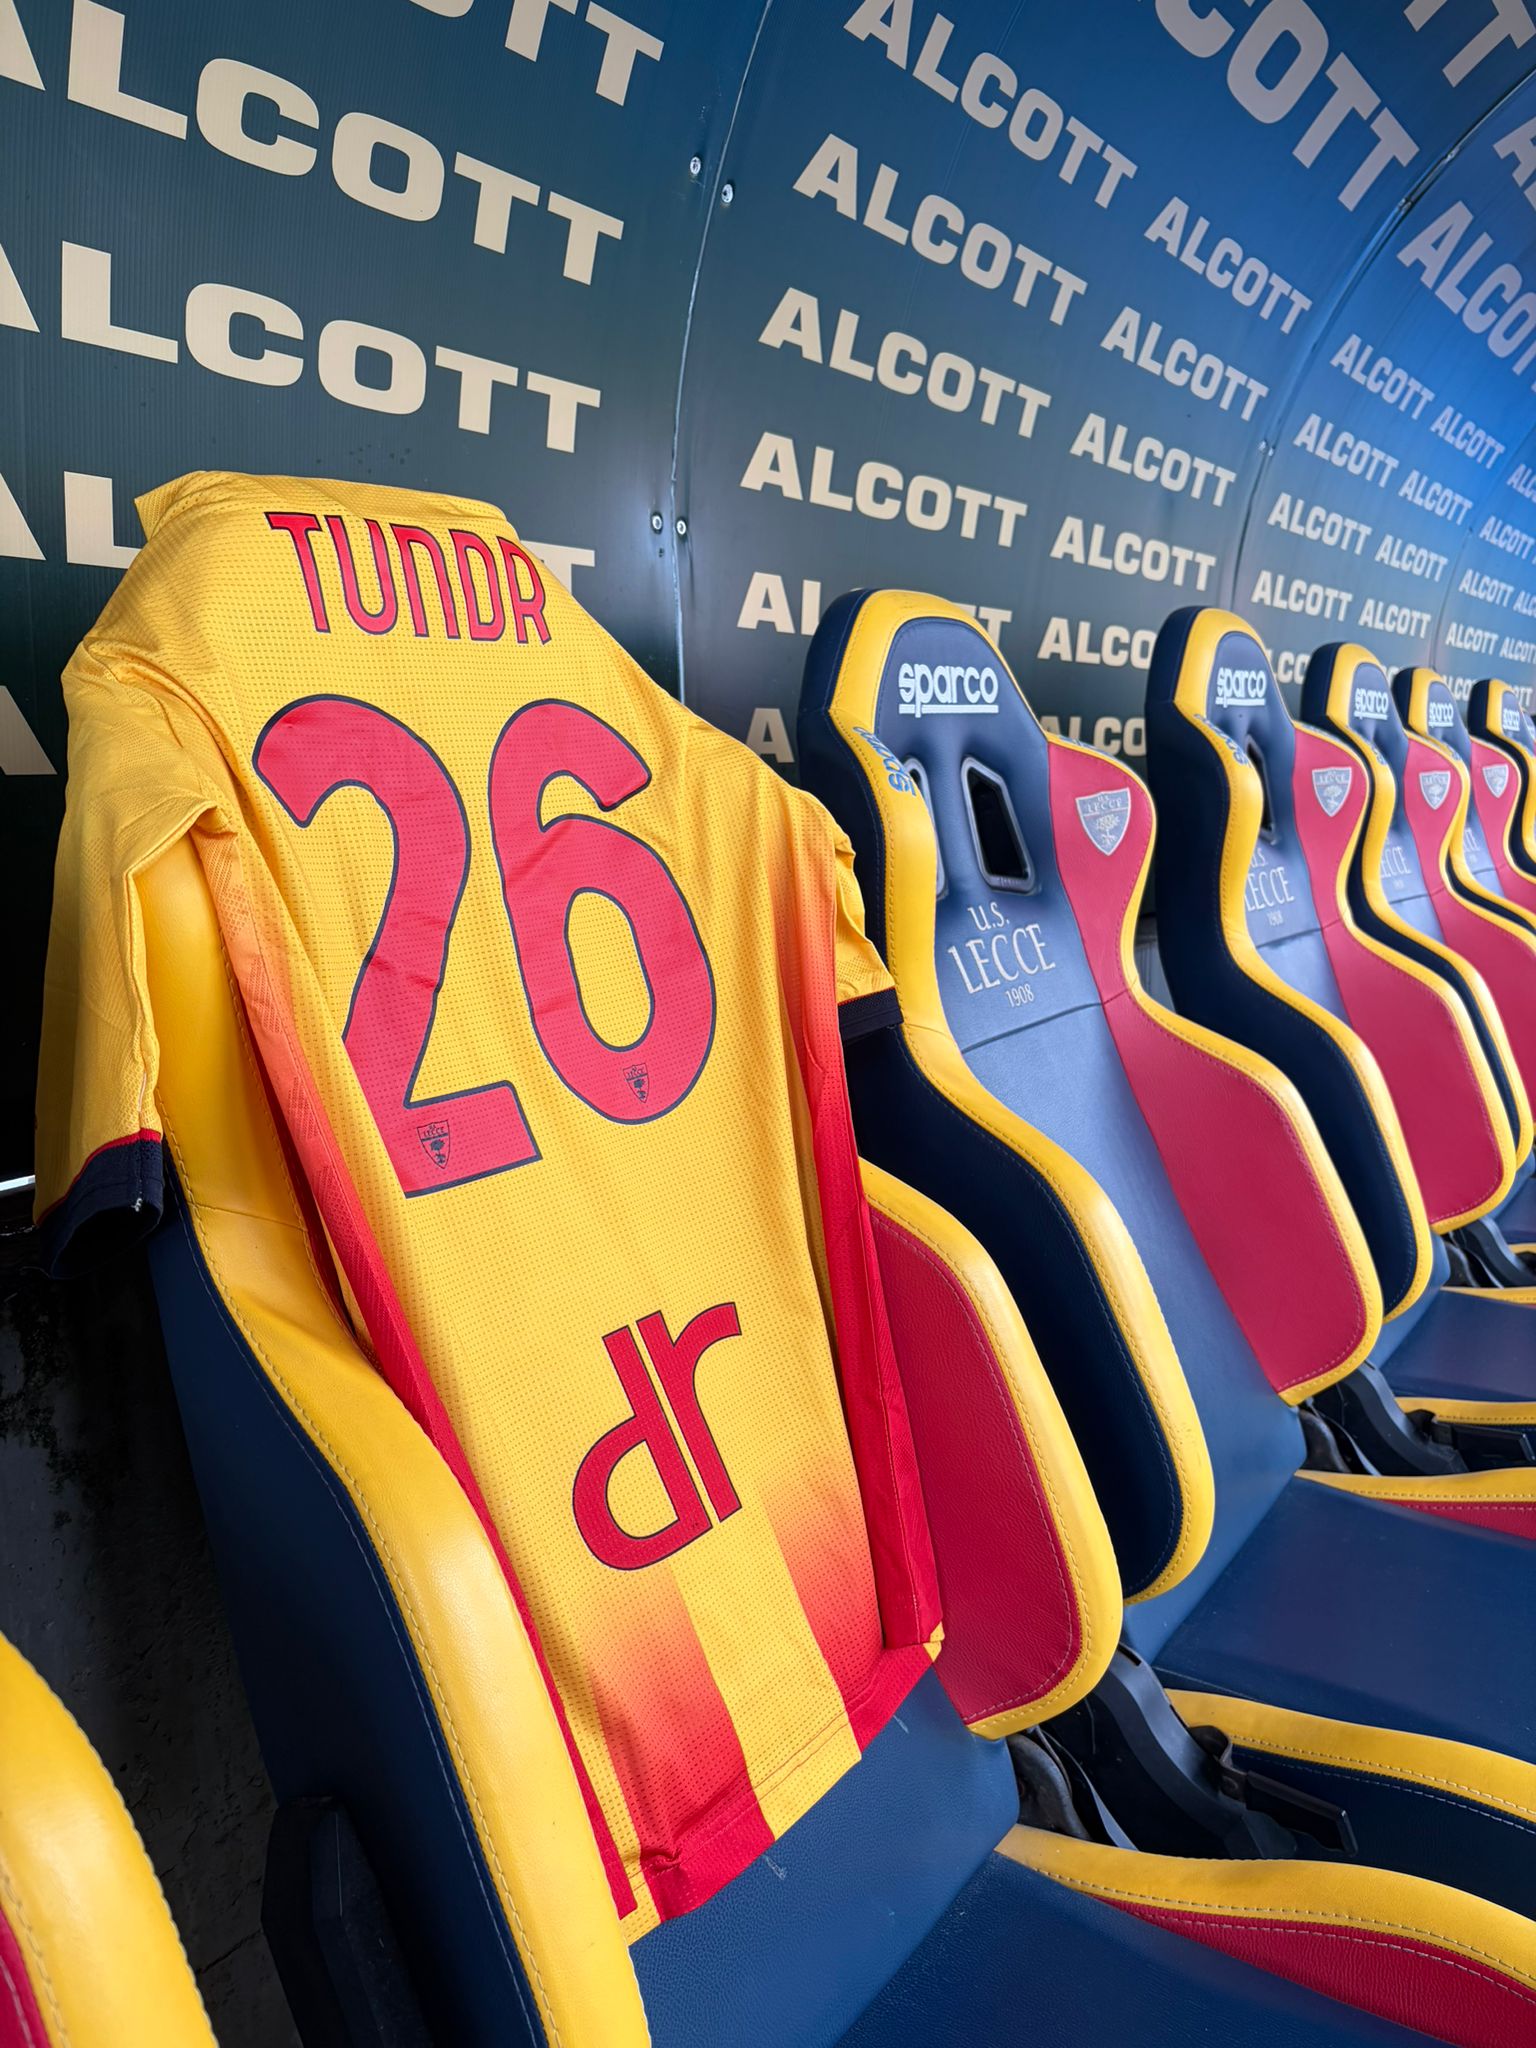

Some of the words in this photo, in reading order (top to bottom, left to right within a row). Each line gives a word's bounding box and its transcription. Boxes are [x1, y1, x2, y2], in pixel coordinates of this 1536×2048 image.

[844, 0, 1137, 208] ALCOTT
[1143, 196, 1312, 334] ALCOTT
[793, 134, 1087, 326] ALCOTT
[1101, 306, 1269, 421] ALCOTT
[759, 287, 1051, 439] ALCOTT
[1070, 413, 1236, 507] ALCOTT
[1329, 334, 1435, 420] ALCOTT
[1430, 405, 1505, 469] ALCOTT
[1293, 413, 1399, 488] ALCOTT
[1398, 469, 1473, 525] ALCOTT
[739, 432, 1027, 547] ALCOTT
[1050, 516, 1216, 591] ALCOTT
[1267, 492, 1372, 555] ALCOTT
[1375, 534, 1448, 582] ALCOTT
[1479, 515, 1536, 560] ALCOTT
[264, 511, 552, 646] TUNDR
[1251, 570, 1353, 622] ALCOTT
[1358, 598, 1432, 639] ALCOTT
[1458, 568, 1515, 608] ALCOTT
[1445, 622, 1499, 655] ALCOTT
[899, 663, 1000, 718] sparco
[1215, 667, 1267, 708] sparco
[1353, 687, 1389, 720] sparco
[252, 693, 718, 1199] 26
[967, 901, 1010, 931] U.S.
[948, 923, 1056, 994] LECCE
[1005, 983, 1035, 1008] 1908
